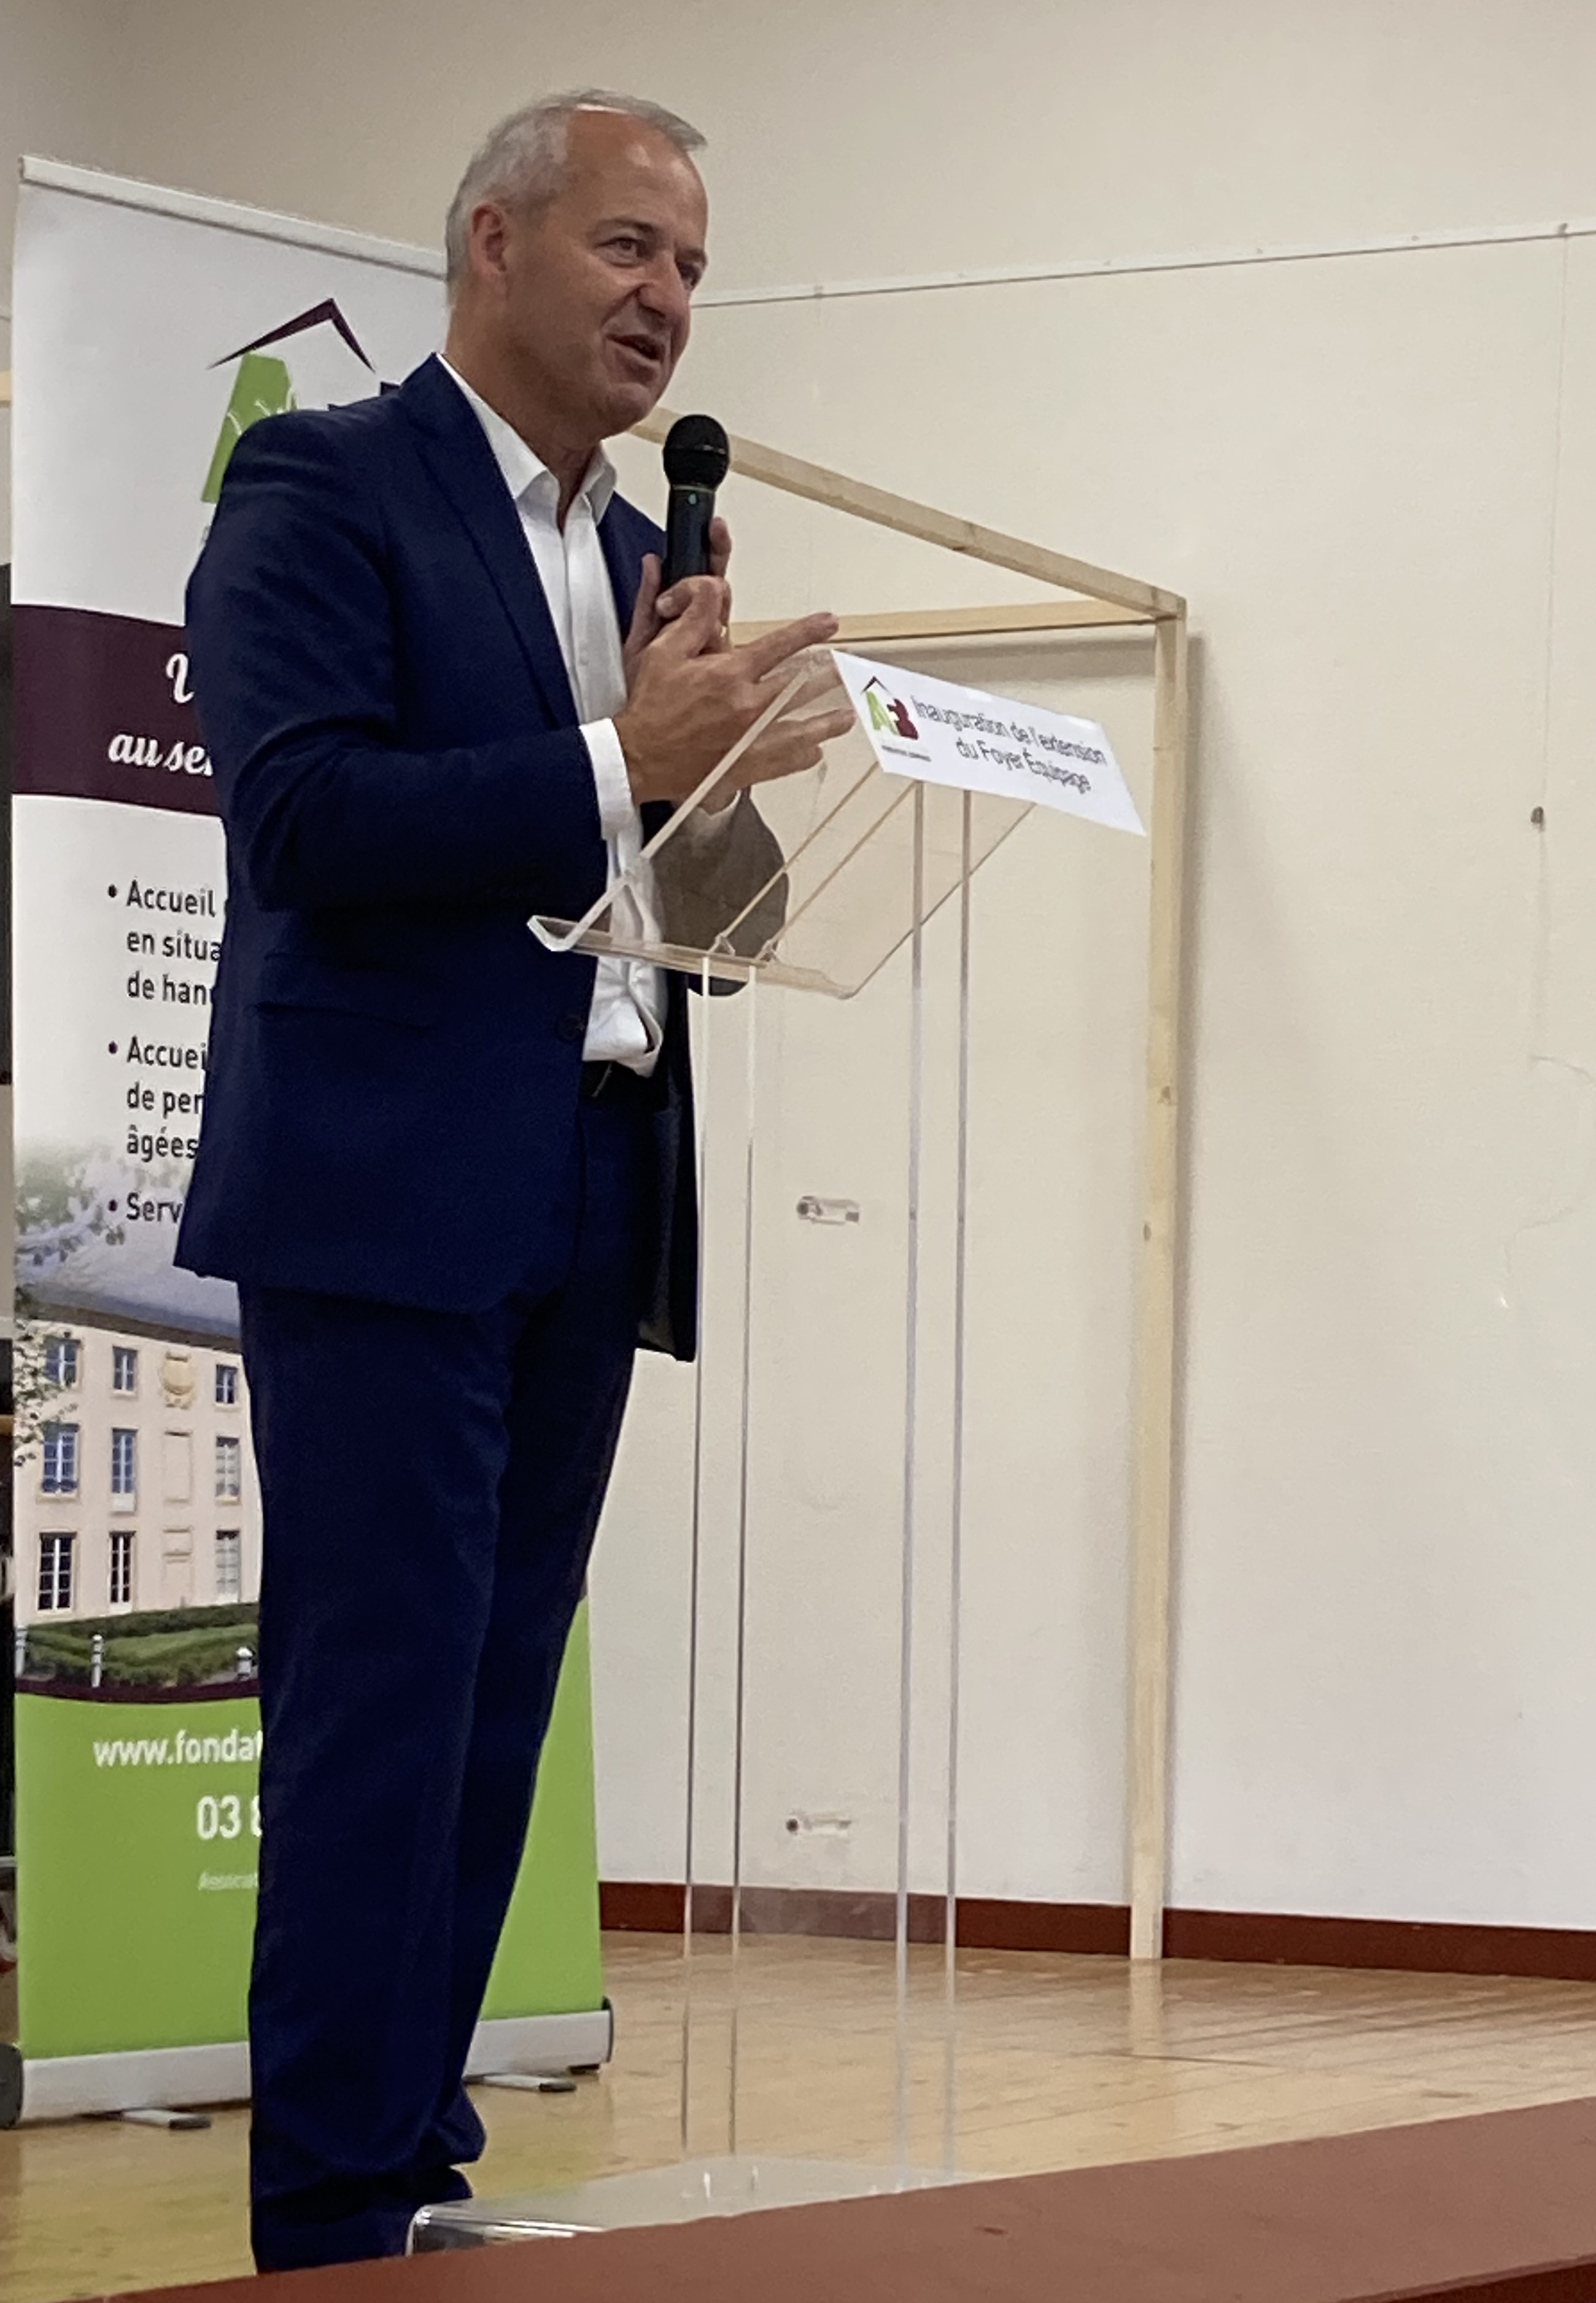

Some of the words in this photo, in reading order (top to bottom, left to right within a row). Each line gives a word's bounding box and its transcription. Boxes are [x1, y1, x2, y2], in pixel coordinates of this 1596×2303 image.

[910, 695, 1012, 739] Inauguration
[1010, 722, 1032, 745] de
[108, 733, 163, 767] au
[956, 737, 979, 759] du
[976, 739, 1025, 771] Foyer
[127, 879, 216, 918] Accueil
[127, 931, 155, 955] en
[162, 928, 222, 962] situa
[127, 970, 155, 1000] de
[162, 974, 207, 1006] han
[126, 1081, 155, 1110] de
[163, 1090, 204, 1119] per
[126, 1124, 200, 1162] âgées
[126, 1192, 183, 1223] Serv
[196, 1795, 242, 1840] 03
